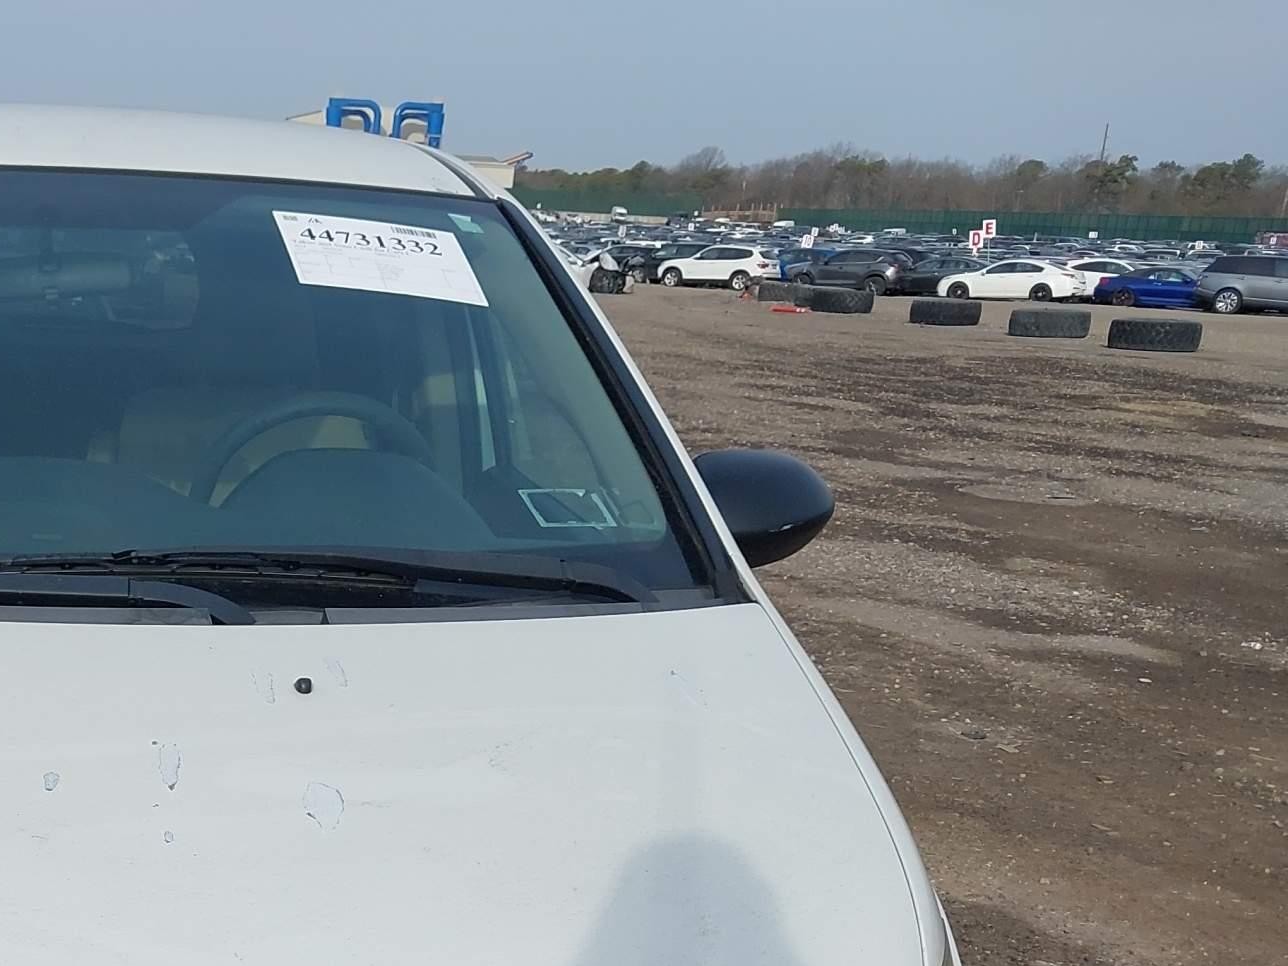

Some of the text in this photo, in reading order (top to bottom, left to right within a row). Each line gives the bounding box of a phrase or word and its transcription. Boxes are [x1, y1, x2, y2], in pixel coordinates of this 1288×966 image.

[985, 221, 994, 235] E
[299, 226, 443, 256] 44731332
[972, 231, 981, 246] D
